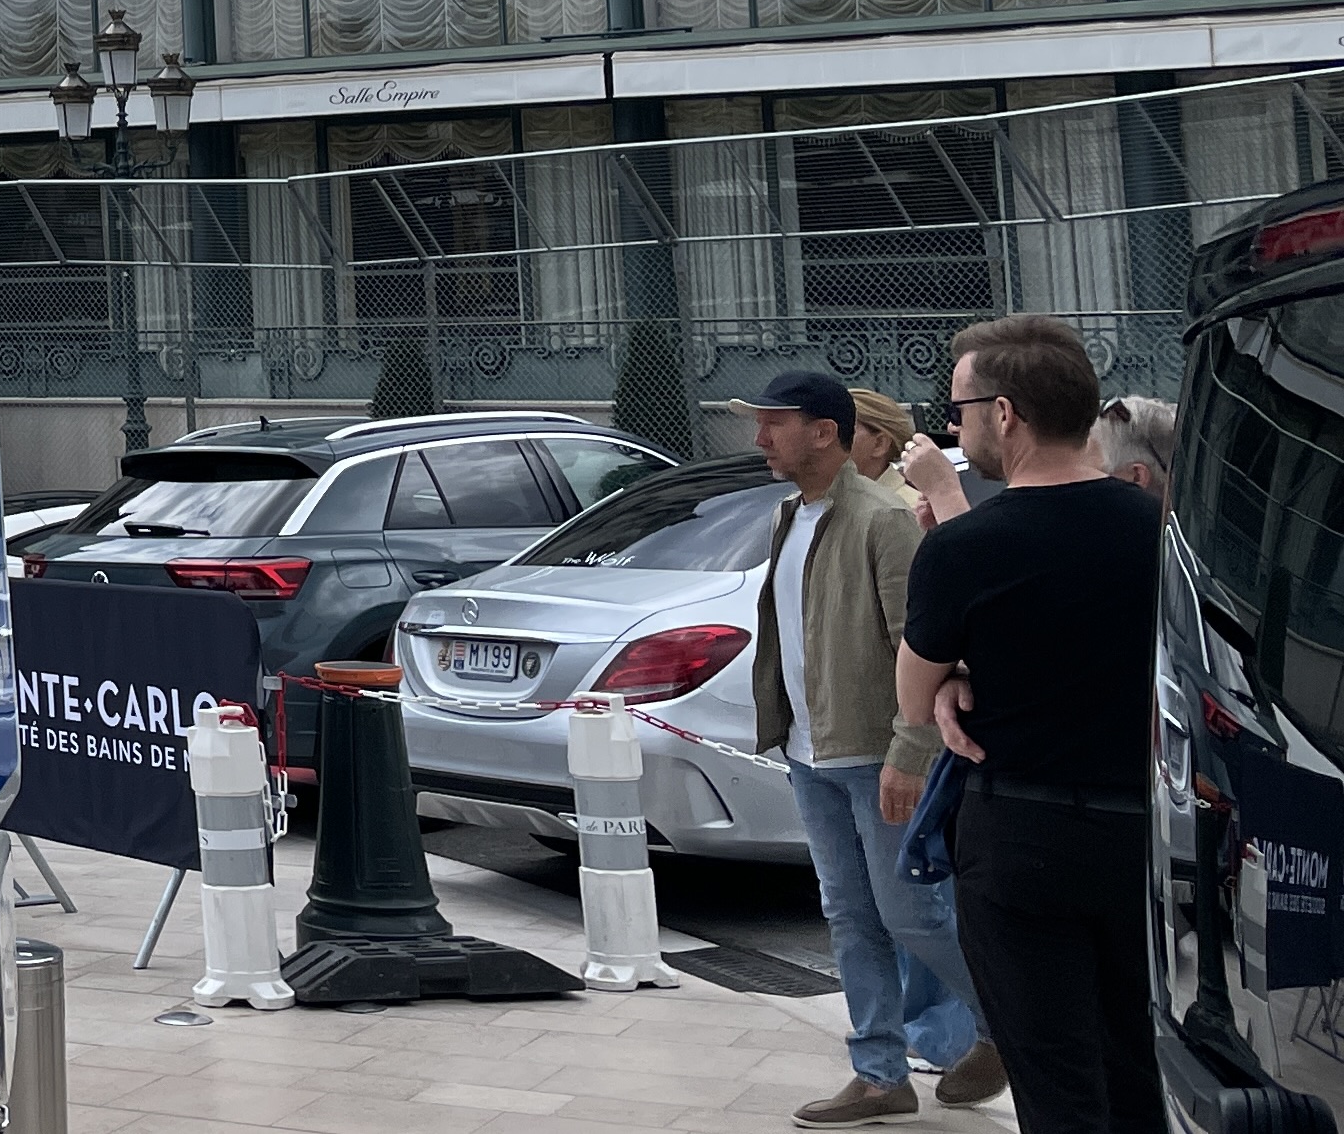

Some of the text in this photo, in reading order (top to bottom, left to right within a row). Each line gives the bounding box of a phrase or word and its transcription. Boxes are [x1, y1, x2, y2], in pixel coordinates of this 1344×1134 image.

[329, 80, 440, 108] Salle Empire
[468, 643, 512, 669] M199
[46, 728, 79, 755] DES
[86, 734, 144, 765] BAINS
[150, 742, 177, 771] DE
